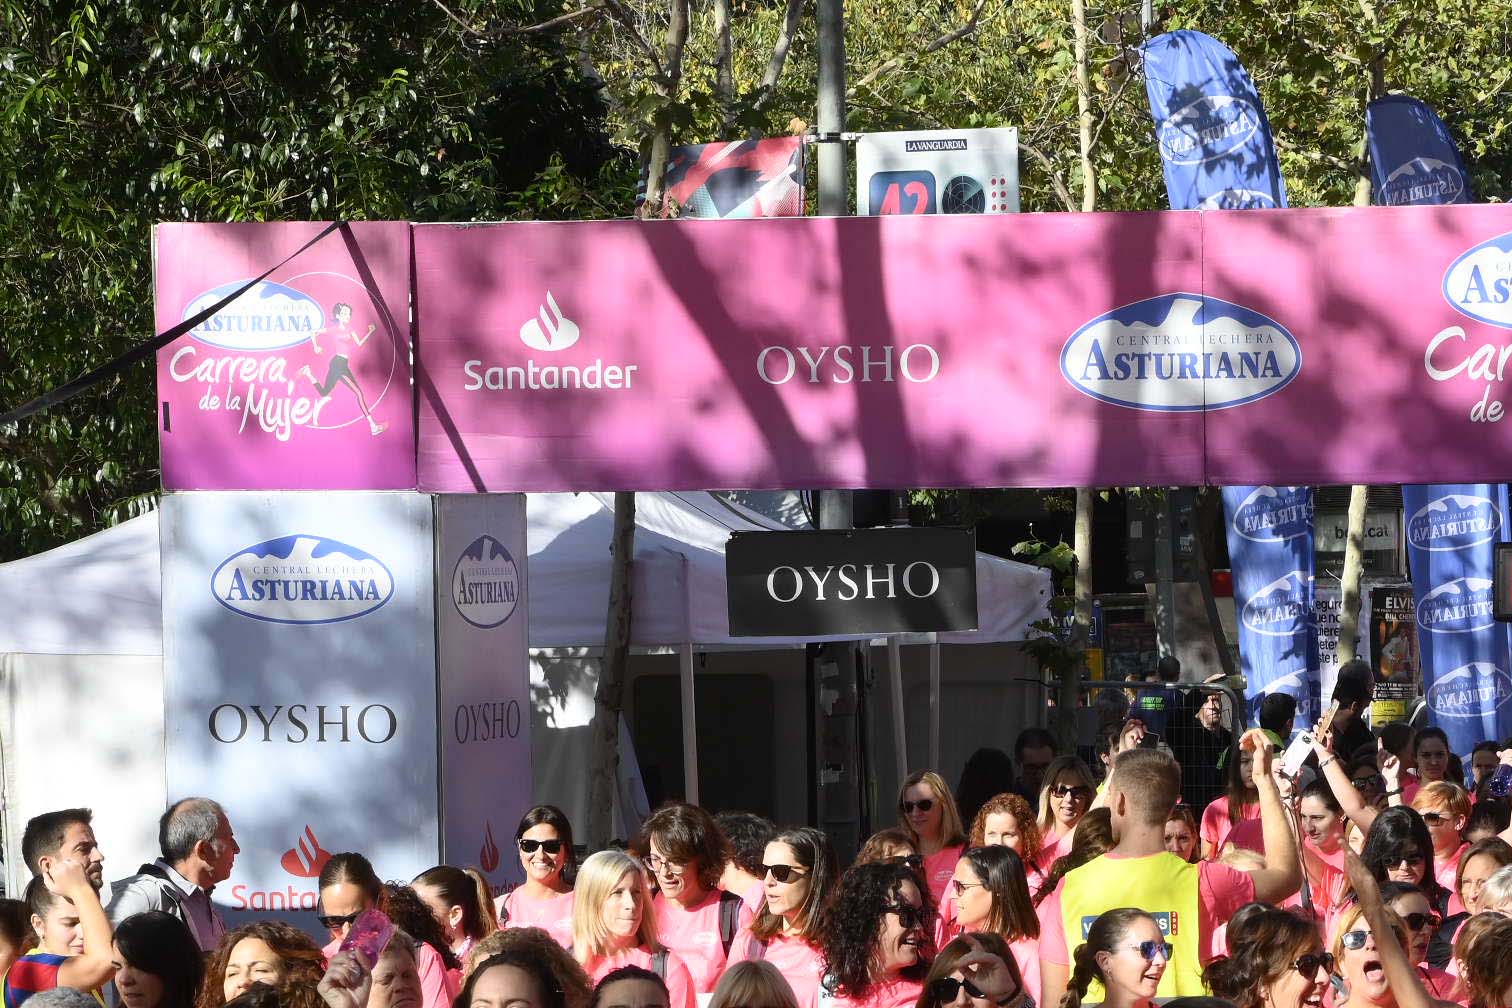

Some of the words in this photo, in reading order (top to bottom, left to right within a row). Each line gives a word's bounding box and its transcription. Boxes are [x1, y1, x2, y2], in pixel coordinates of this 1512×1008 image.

[907, 141, 917, 151] LA
[917, 140, 966, 150] VANGUARDIA
[193, 305, 313, 332] ASTURIANA
[1117, 334, 1189, 347] CENTRAL
[1199, 333, 1275, 346] LECHERA
[169, 346, 288, 383] Carrera
[464, 359, 638, 390] Santander
[756, 342, 941, 385] OYSHO
[1079, 338, 1283, 382] ASTURIANA
[199, 384, 220, 411] de
[225, 382, 241, 411] la
[238, 380, 332, 442] Mujer
[1470, 384, 1504, 424] de
[225, 567, 382, 601] ASTURIANA
[253, 565, 311, 575] CENTRAL
[458, 568, 515, 605] ASTURIANA
[766, 560, 940, 603] OYSHO
[208, 703, 398, 744] OYSHO
[454, 700, 521, 745] OYSHO
[231, 884, 318, 912] Santa
